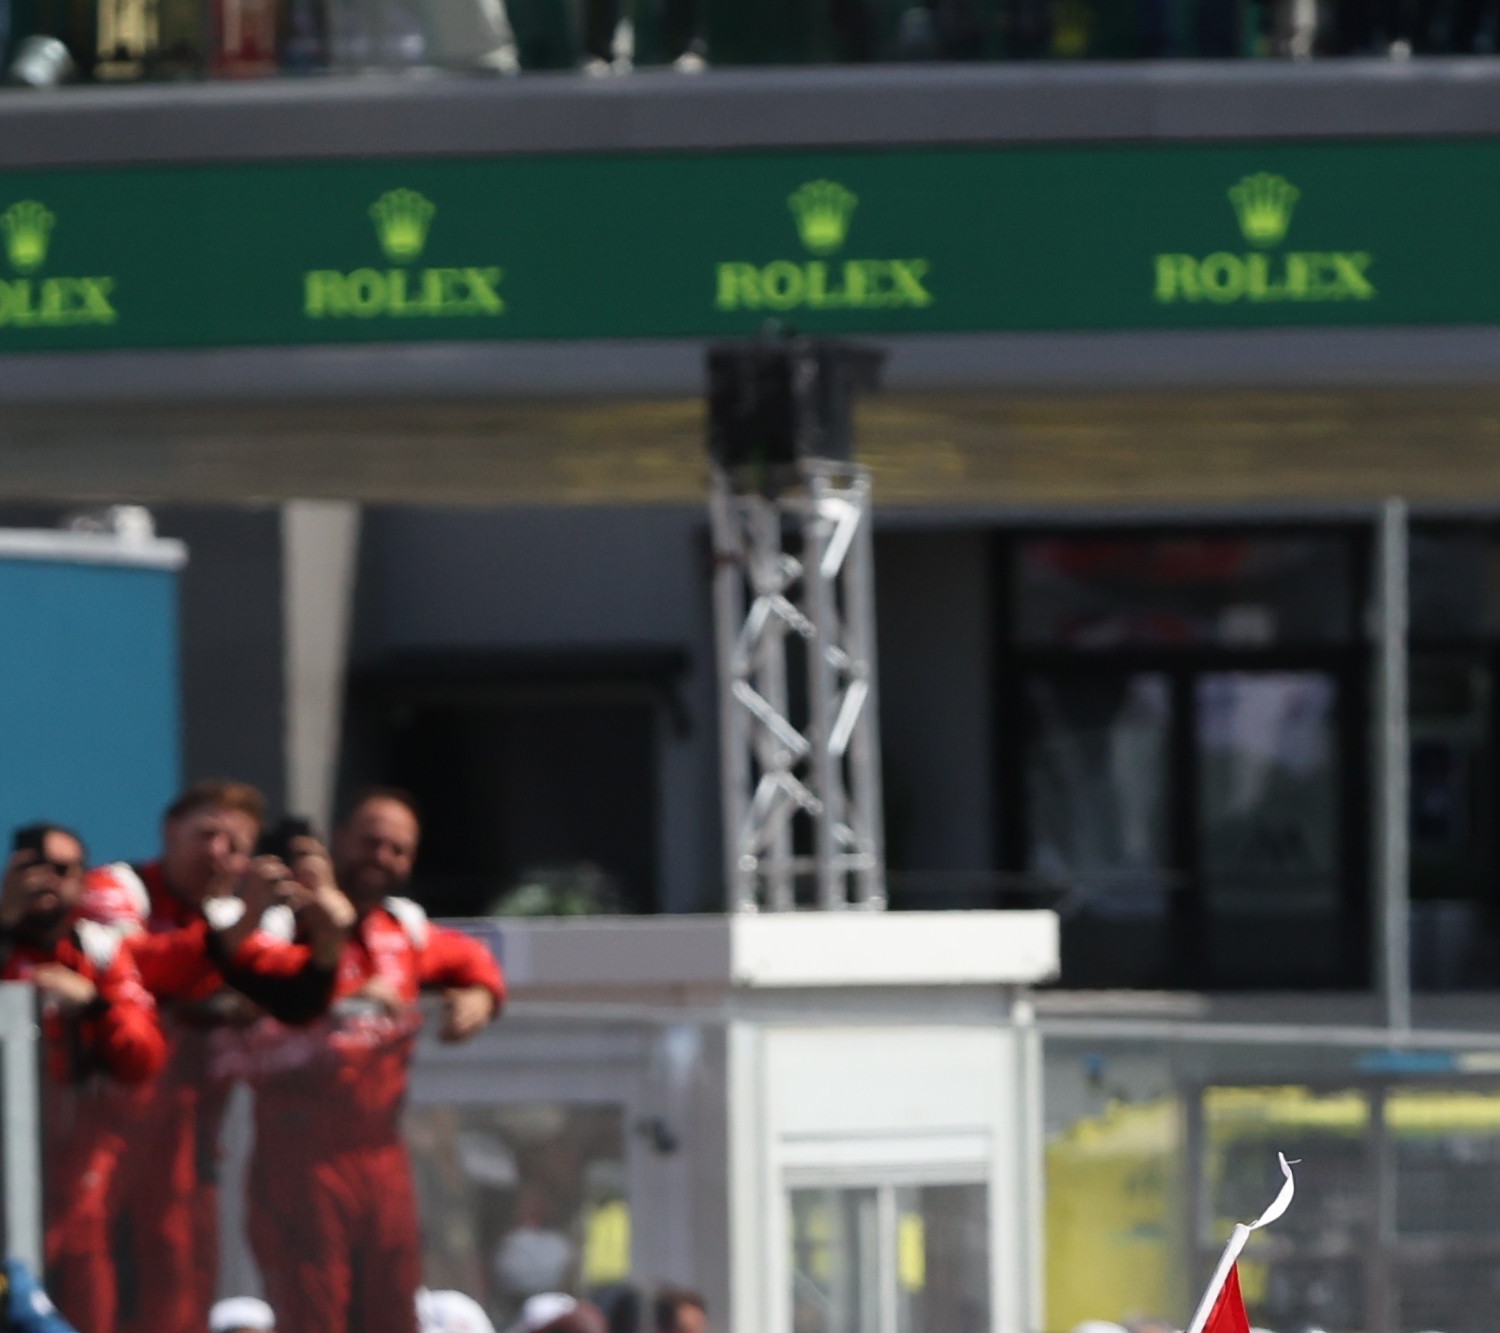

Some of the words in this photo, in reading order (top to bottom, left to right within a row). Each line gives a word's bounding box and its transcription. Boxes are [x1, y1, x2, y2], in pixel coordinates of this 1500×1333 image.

[306, 268, 503, 316] ROLEX
[717, 260, 930, 308] ROLEX
[1156, 253, 1373, 300] ROLEX
